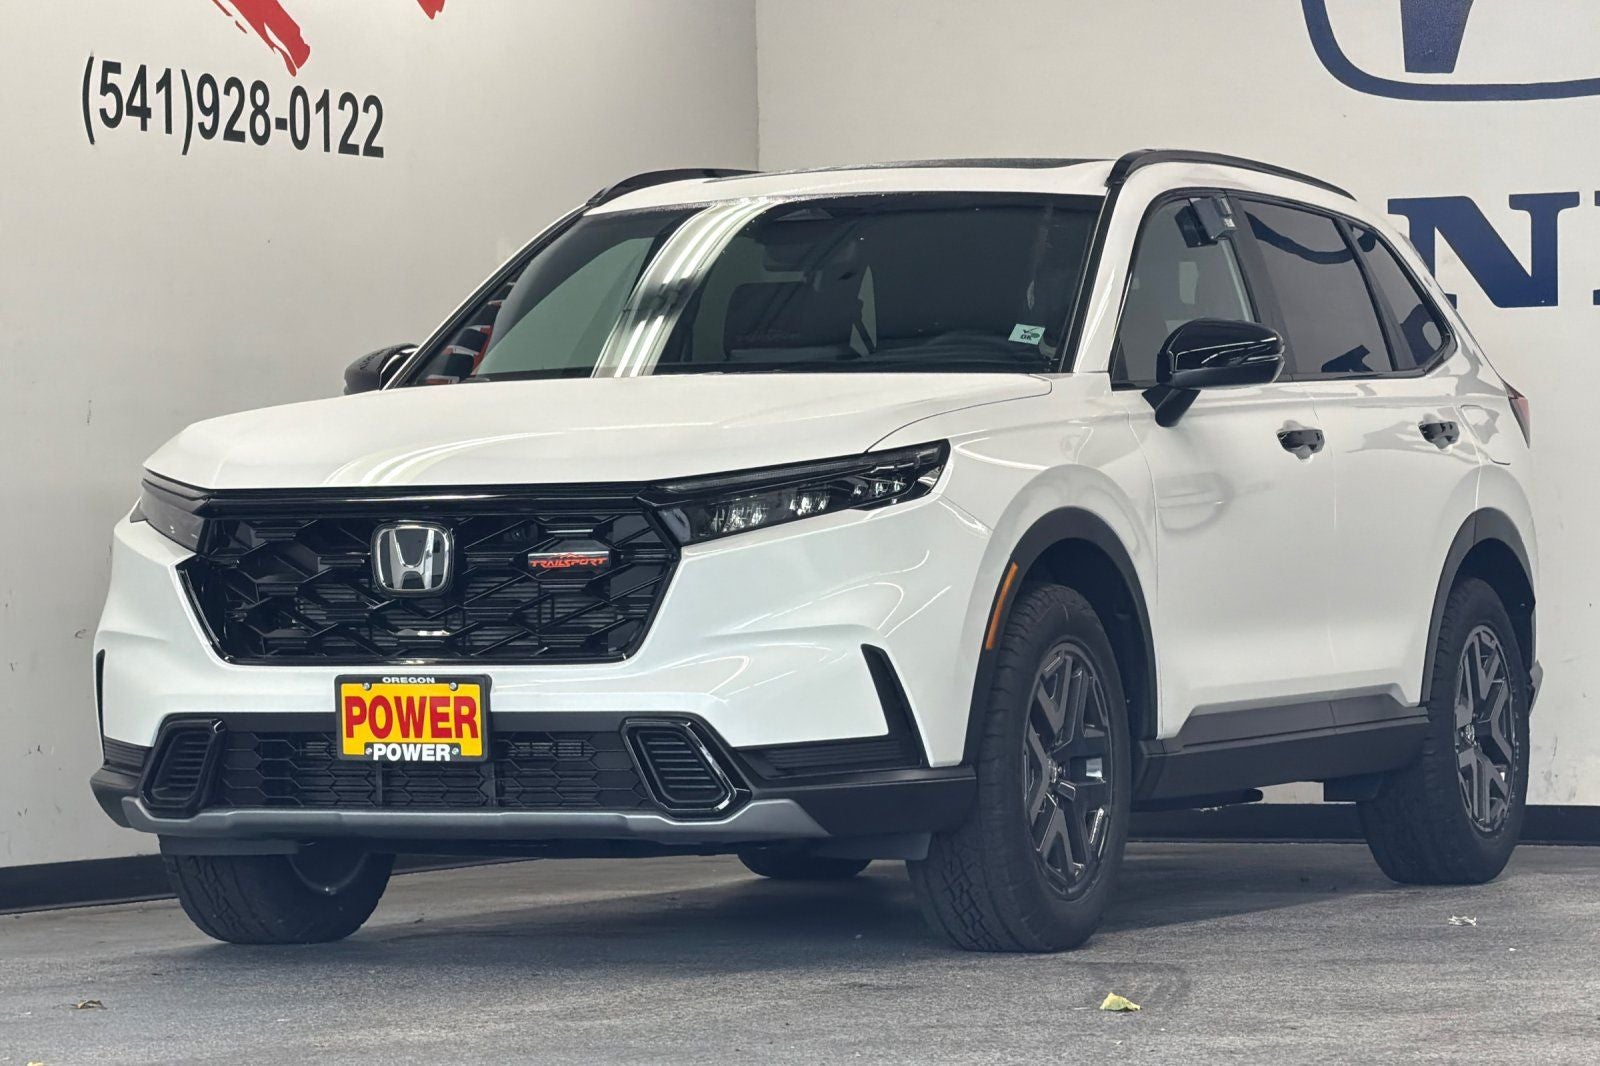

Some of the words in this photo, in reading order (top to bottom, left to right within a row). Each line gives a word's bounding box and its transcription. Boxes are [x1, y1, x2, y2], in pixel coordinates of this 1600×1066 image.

[82, 53, 385, 158] (541)928-0122
[1388, 190, 1600, 309] N
[529, 557, 609, 568] TRAILSPORT
[382, 676, 436, 684] OREGON
[344, 695, 479, 739] POWER
[373, 743, 451, 762] POWER
